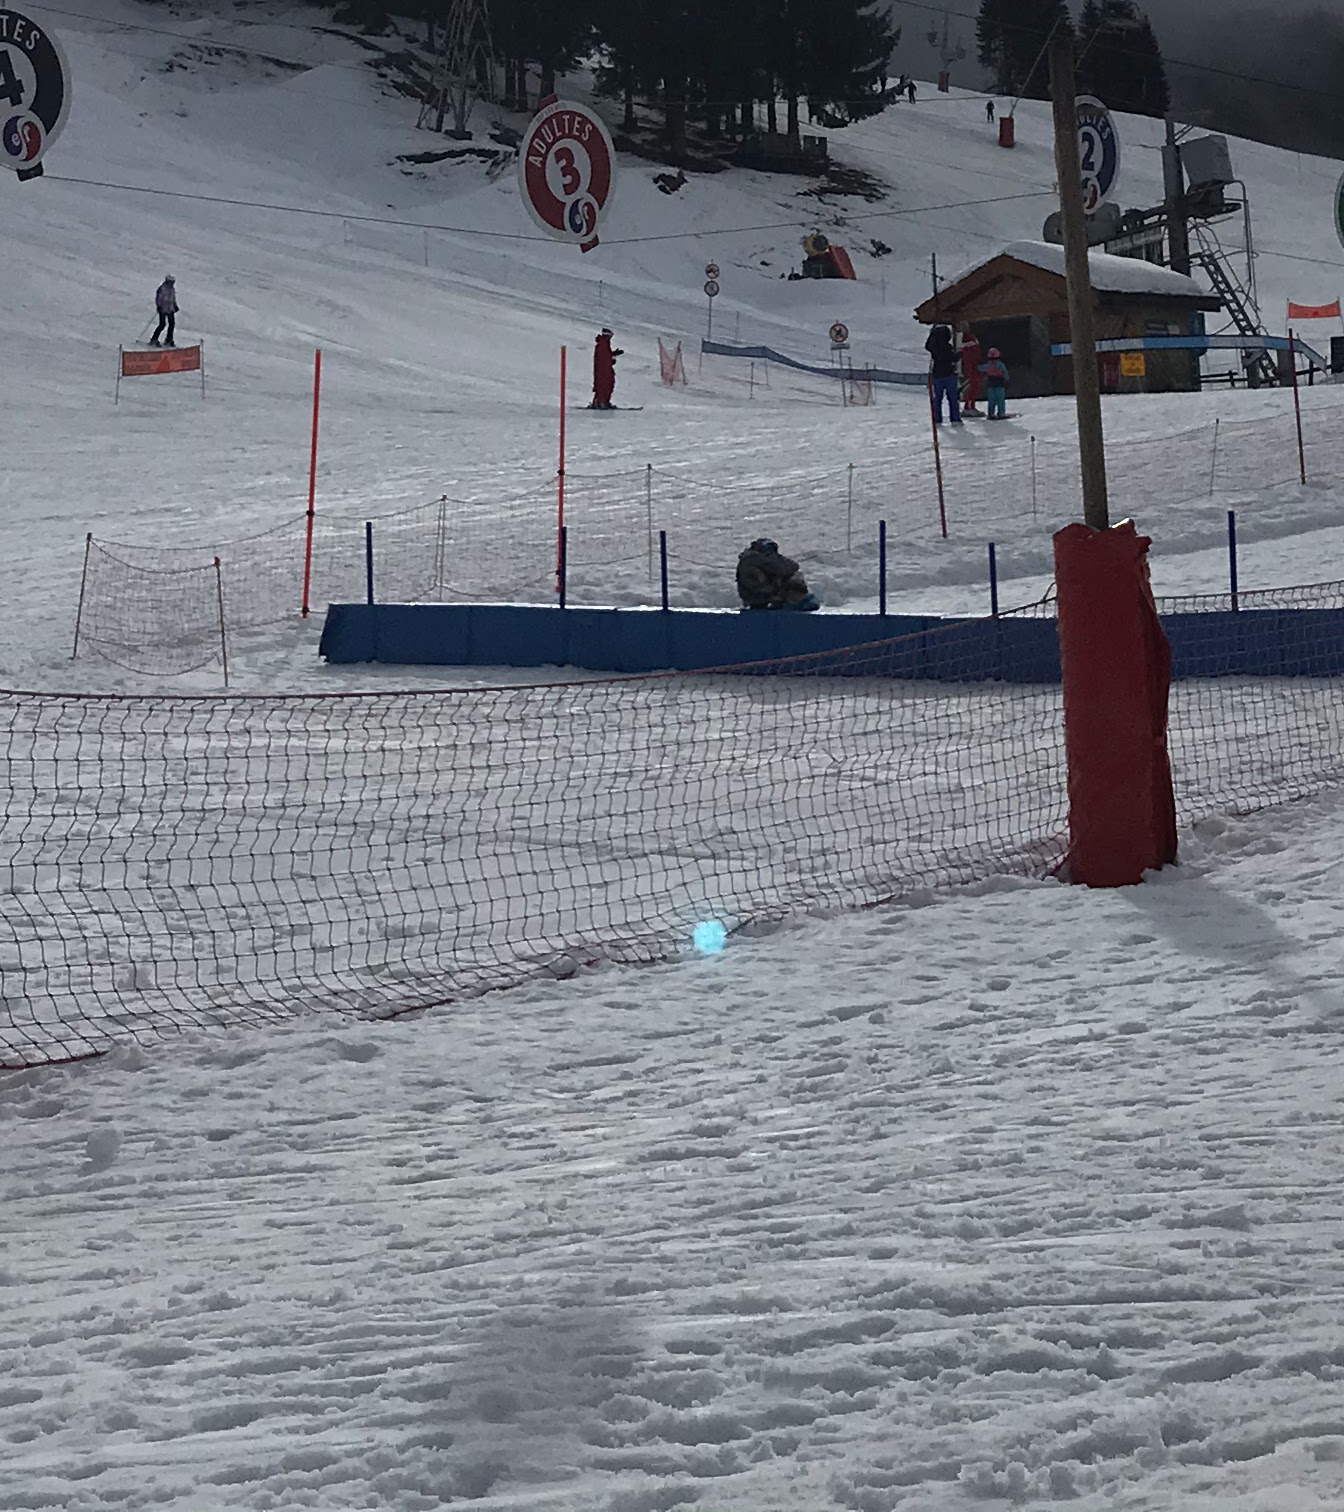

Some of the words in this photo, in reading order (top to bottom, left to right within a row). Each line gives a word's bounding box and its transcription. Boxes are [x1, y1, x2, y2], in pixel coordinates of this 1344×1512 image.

[528, 114, 592, 168] ADULTES
[1081, 131, 1095, 171] 2
[554, 146, 581, 196] 3
